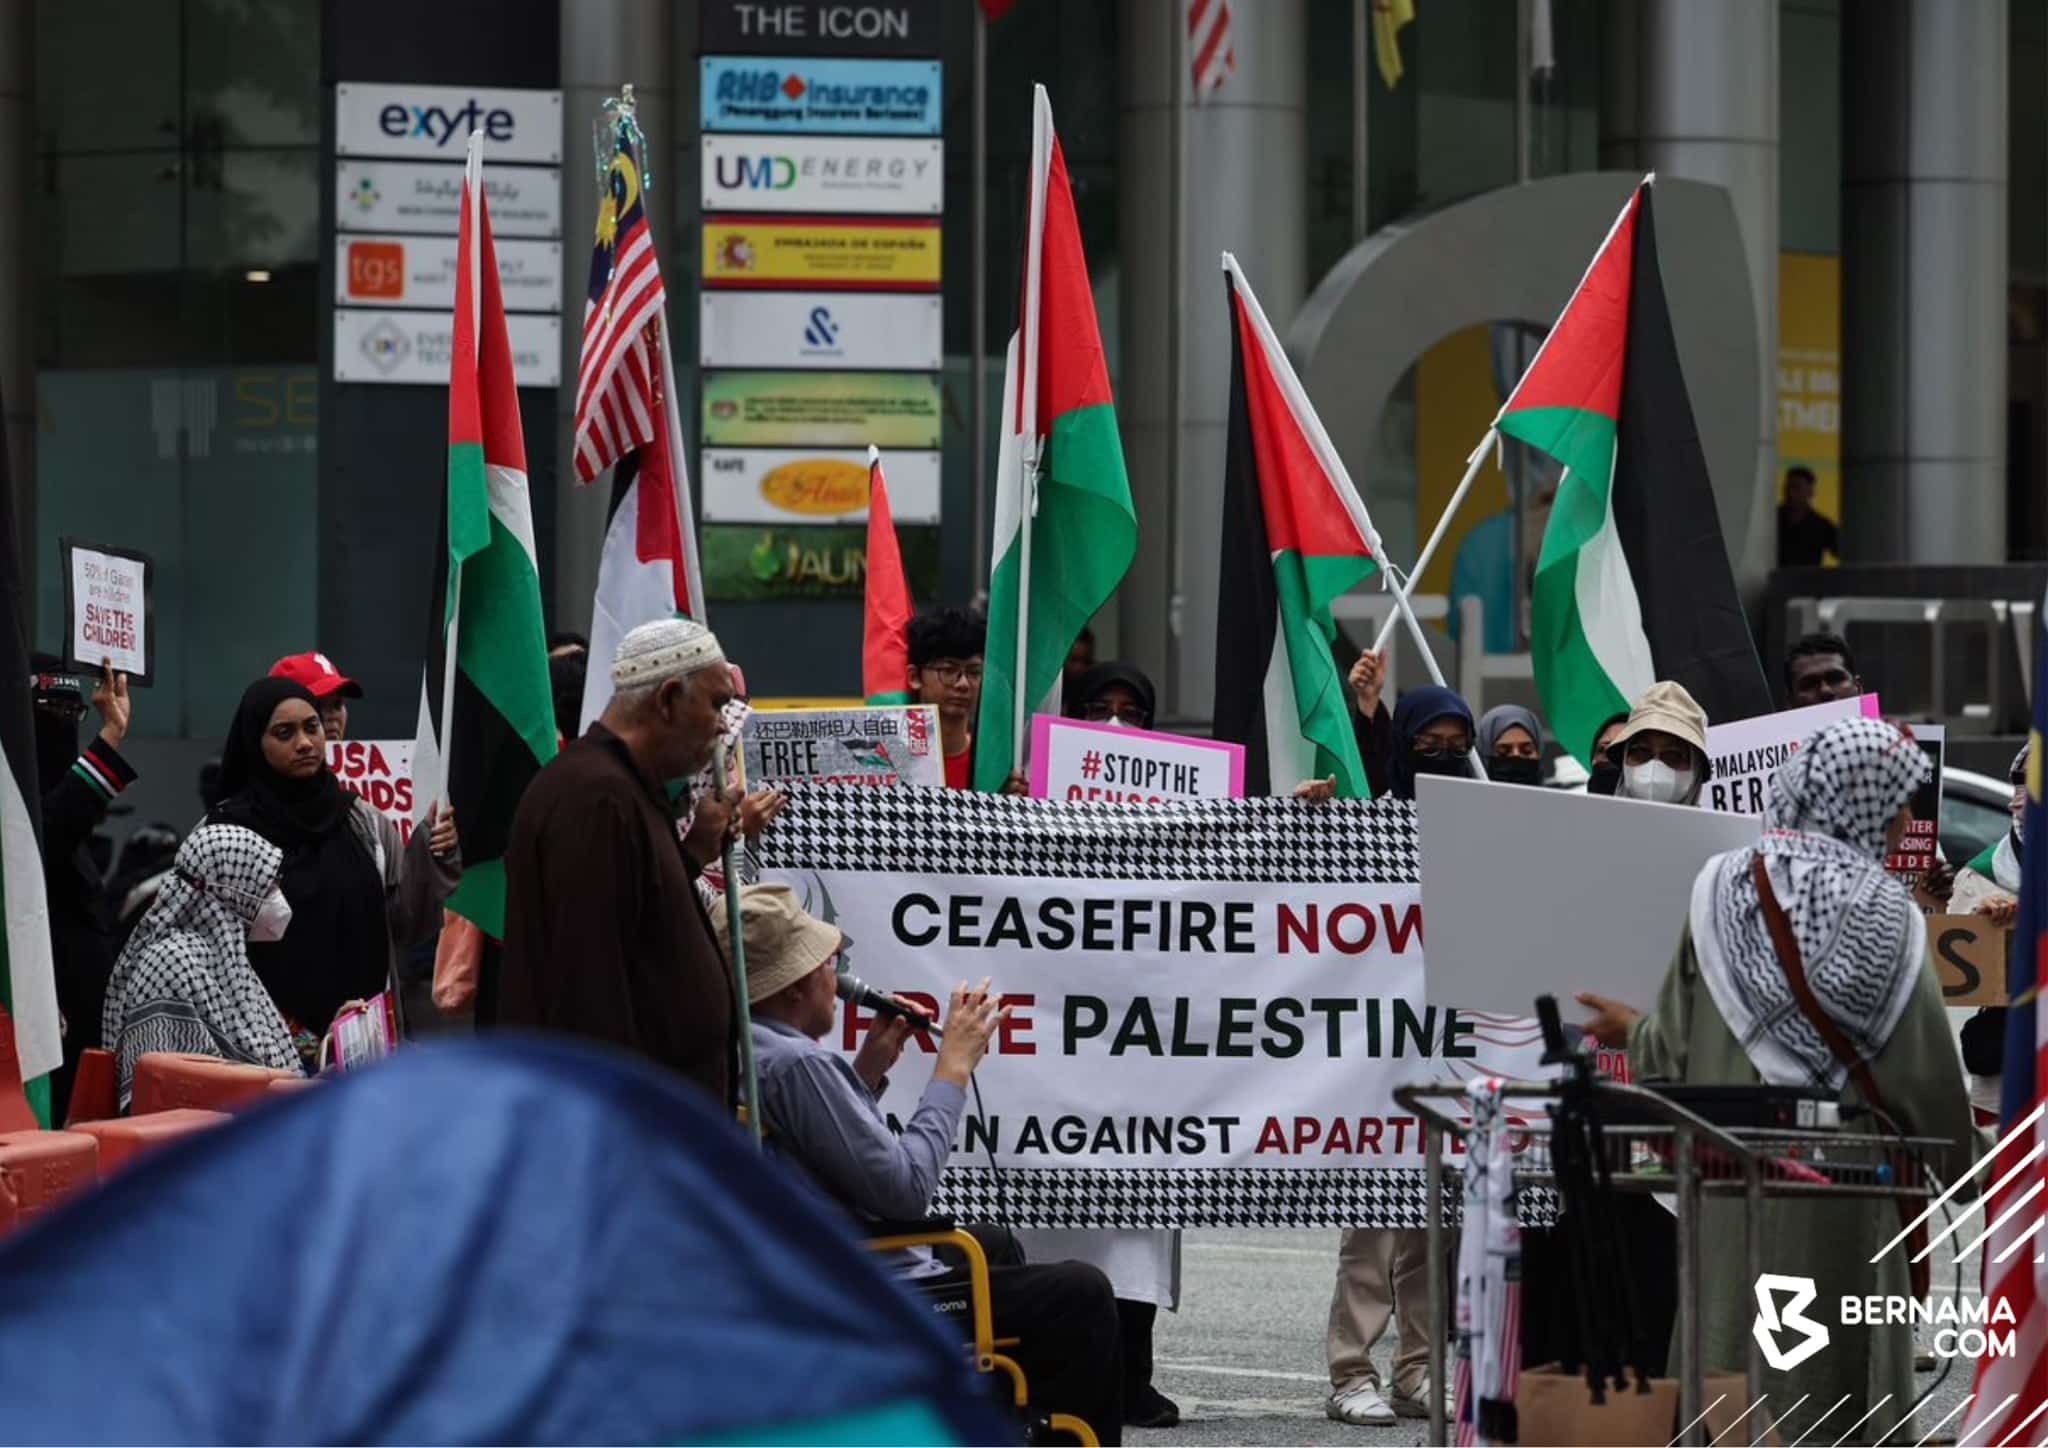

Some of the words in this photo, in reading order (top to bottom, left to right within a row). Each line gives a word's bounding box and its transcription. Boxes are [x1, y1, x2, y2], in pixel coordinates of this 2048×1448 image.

[735, 5, 806, 36] THE
[819, 8, 908, 38] ICON
[717, 70, 780, 102] RHB
[379, 98, 516, 147] exyte
[801, 157, 929, 178] ENERGY
[352, 256, 401, 290] tgs
[113, 610, 134, 632] THE
[755, 718, 898, 739] 还巴勒斯坦人自由
[760, 740, 819, 777] FREE
[1081, 749, 1200, 796] #STOPTHE
[892, 893, 1256, 953] CEASEFIRE
[1277, 903, 1424, 954] NOW
[1063, 995, 1477, 1059] PALESTINE
[1015, 1116, 1240, 1154] AGAINST
[933, 1300, 968, 1313] soma
